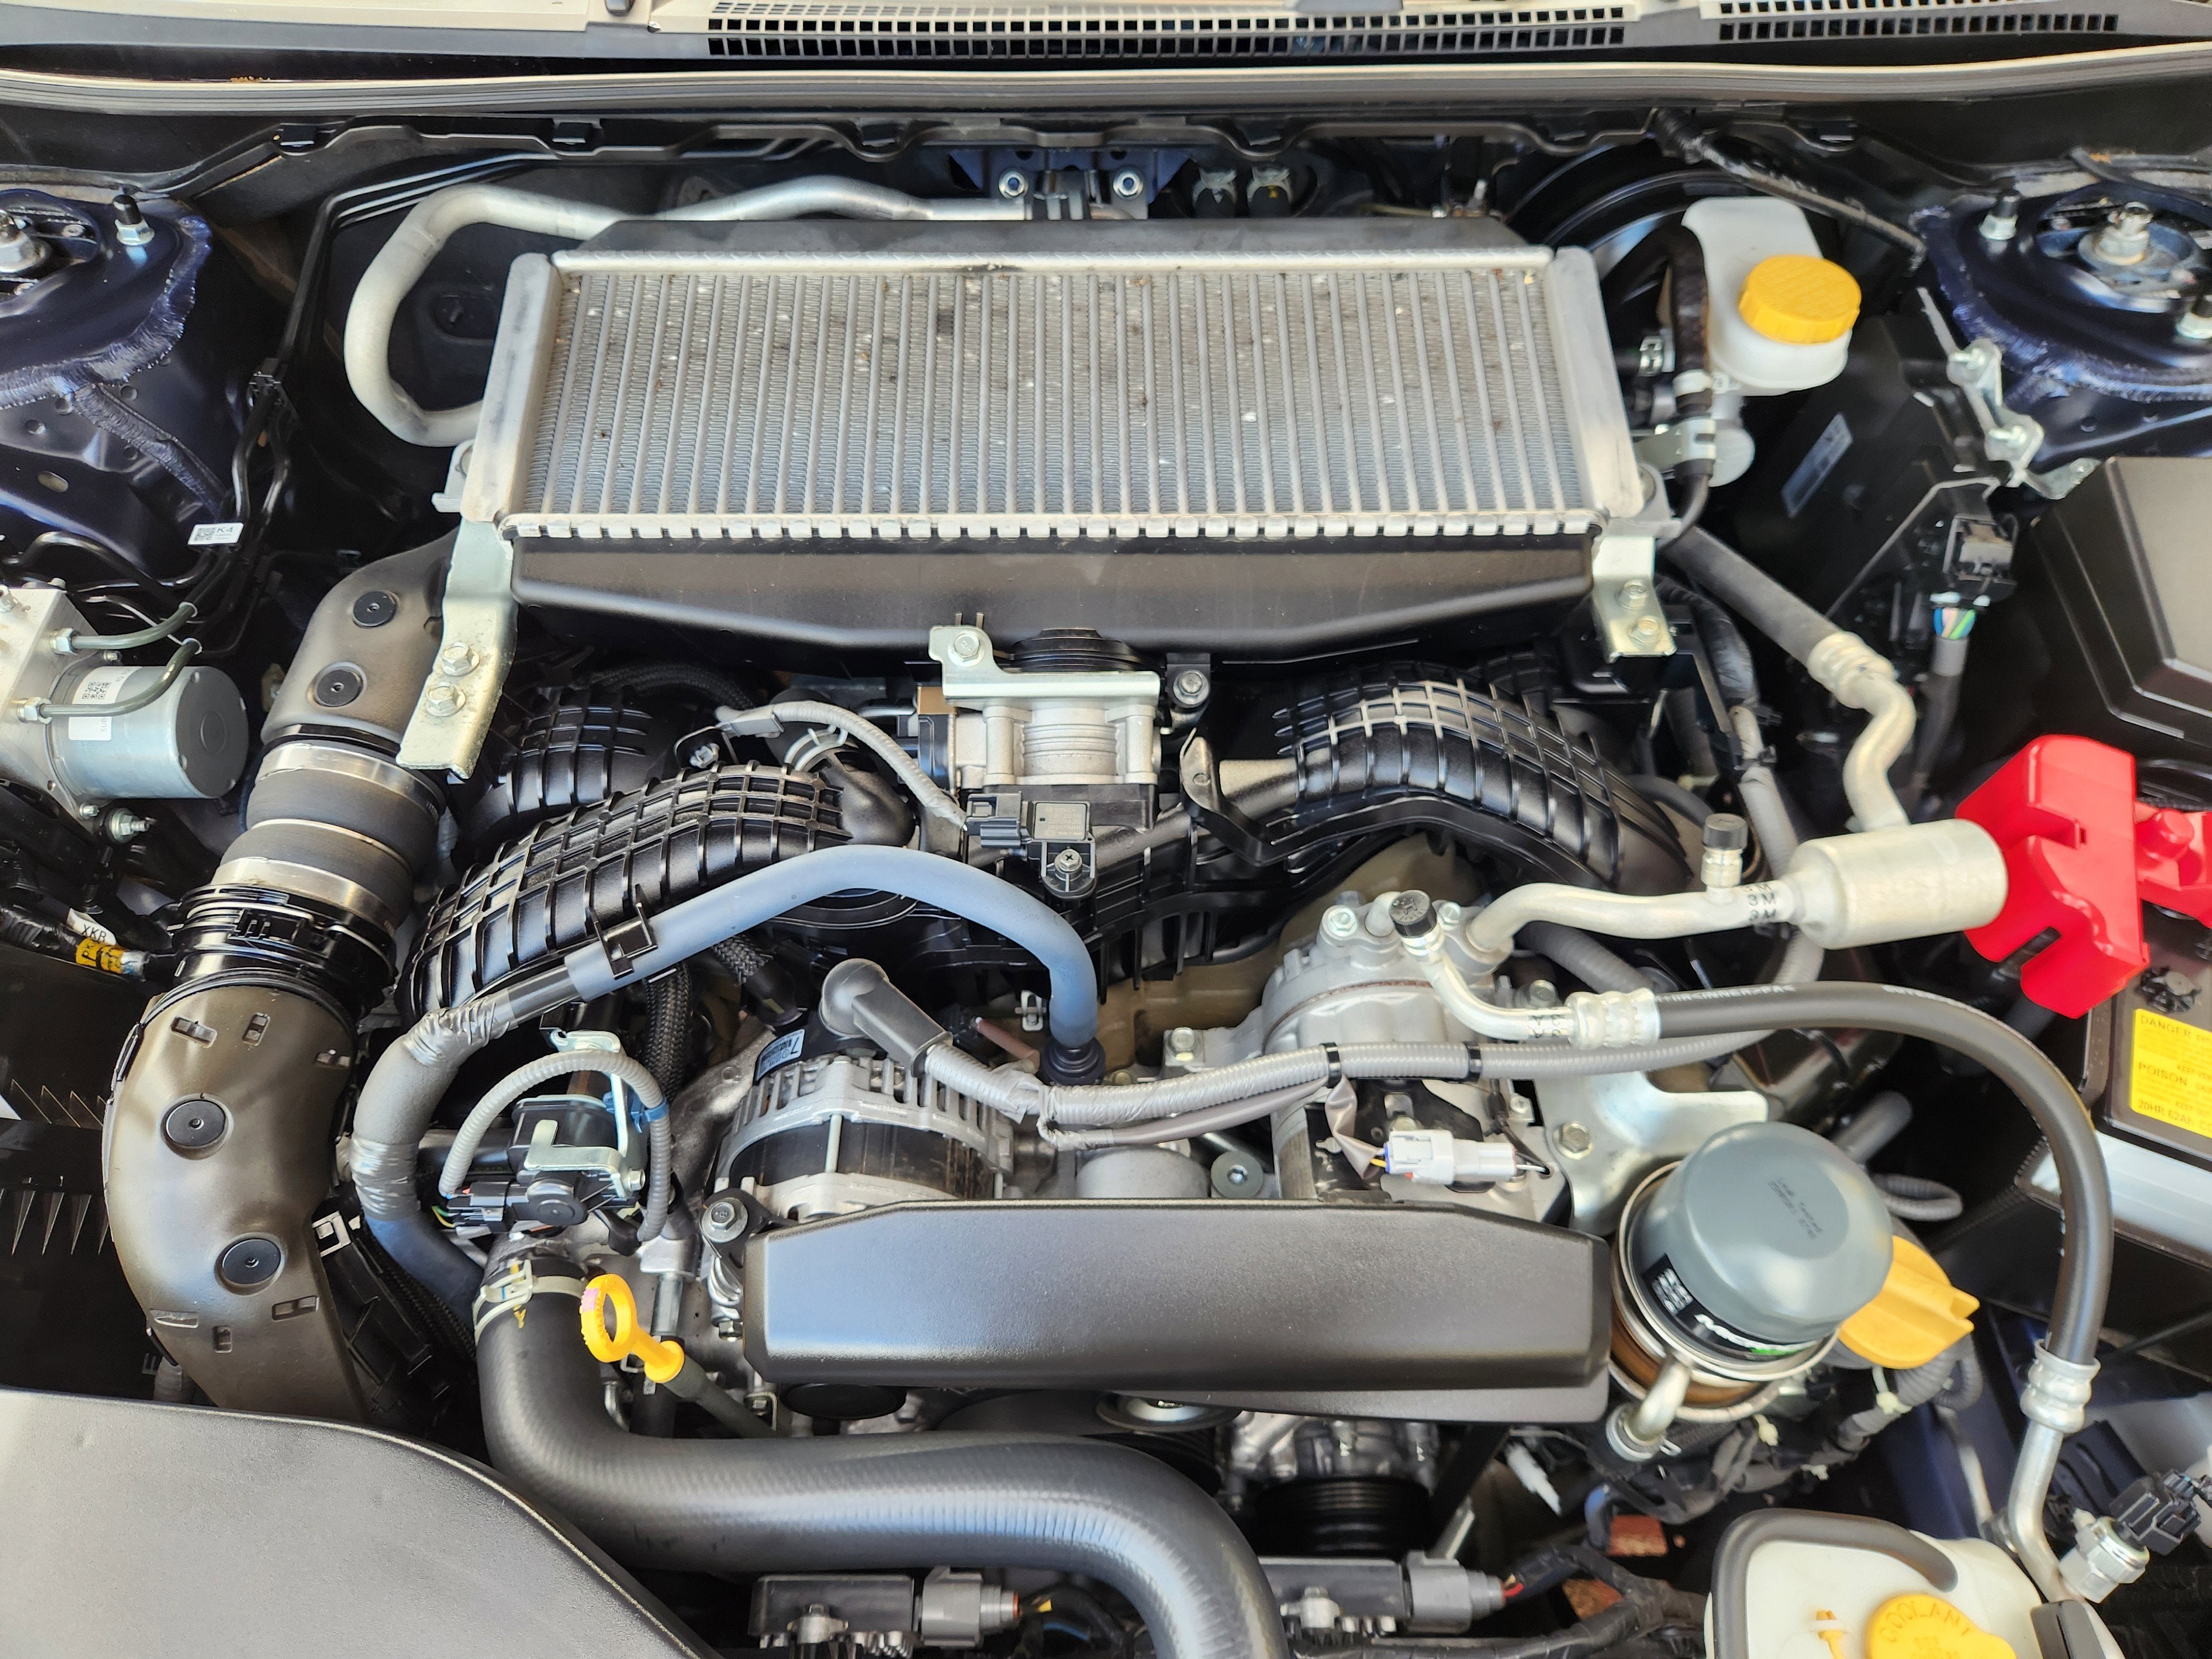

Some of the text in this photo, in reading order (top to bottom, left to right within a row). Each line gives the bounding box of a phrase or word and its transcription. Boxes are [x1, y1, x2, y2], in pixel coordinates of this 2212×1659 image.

[2140, 1015, 2191, 1037] DANGER
[2138, 1062, 2188, 1086] POISON
[1879, 1600, 1970, 1643] COOLANT
